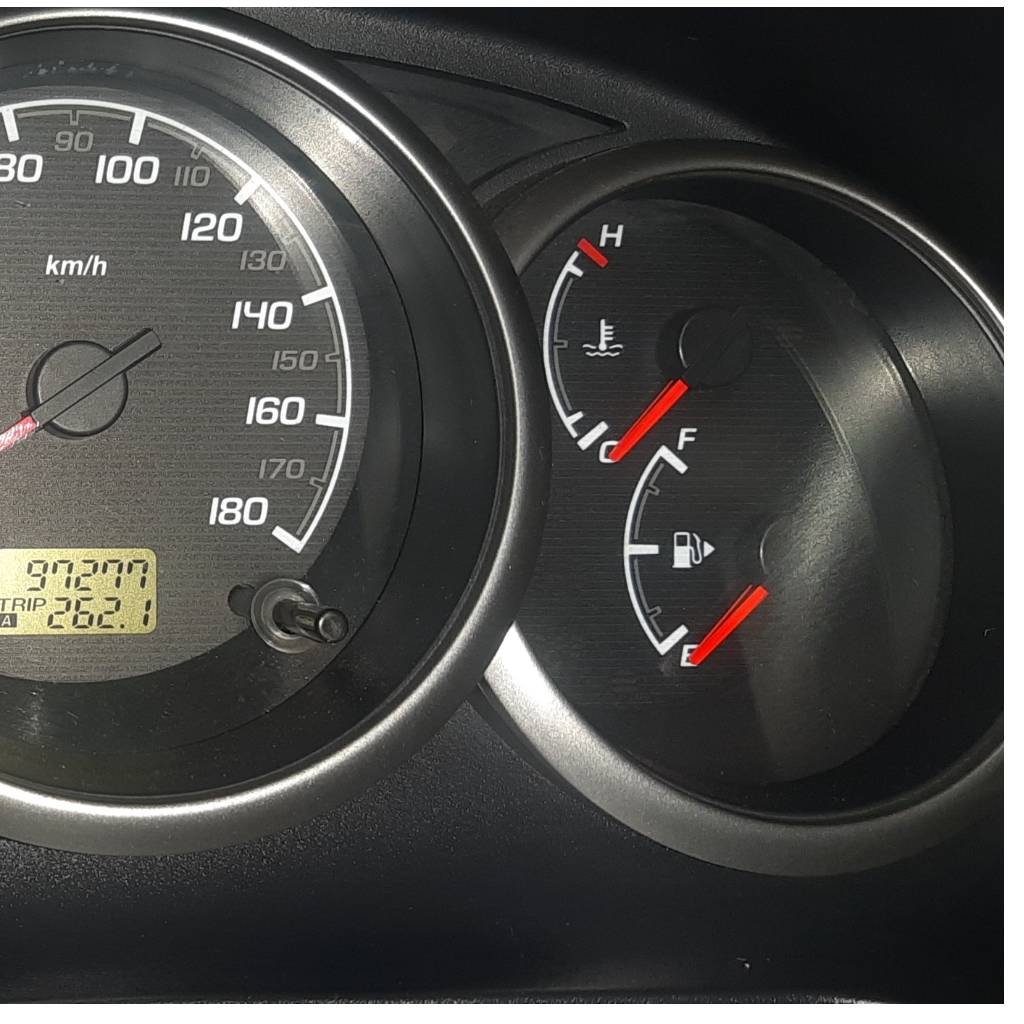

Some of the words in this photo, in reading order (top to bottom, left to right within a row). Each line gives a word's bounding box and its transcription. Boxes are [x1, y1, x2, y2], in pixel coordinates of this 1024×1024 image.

[54, 131, 94, 153] 90
[95, 154, 160, 185] 100
[173, 165, 211, 188] 110
[180, 212, 243, 242] 120
[599, 223, 624, 248] H
[45, 255, 108, 277] km/h
[239, 250, 286, 272] 130
[232, 301, 293, 330] 140
[272, 350, 319, 371] 150
[246, 396, 305, 425] 160
[677, 427, 698, 450] F
[259, 457, 305, 479] 170
[209, 496, 268, 526] 180
[27, 559, 149, 592] 97277
[47, 596, 152, 629] 262.1
